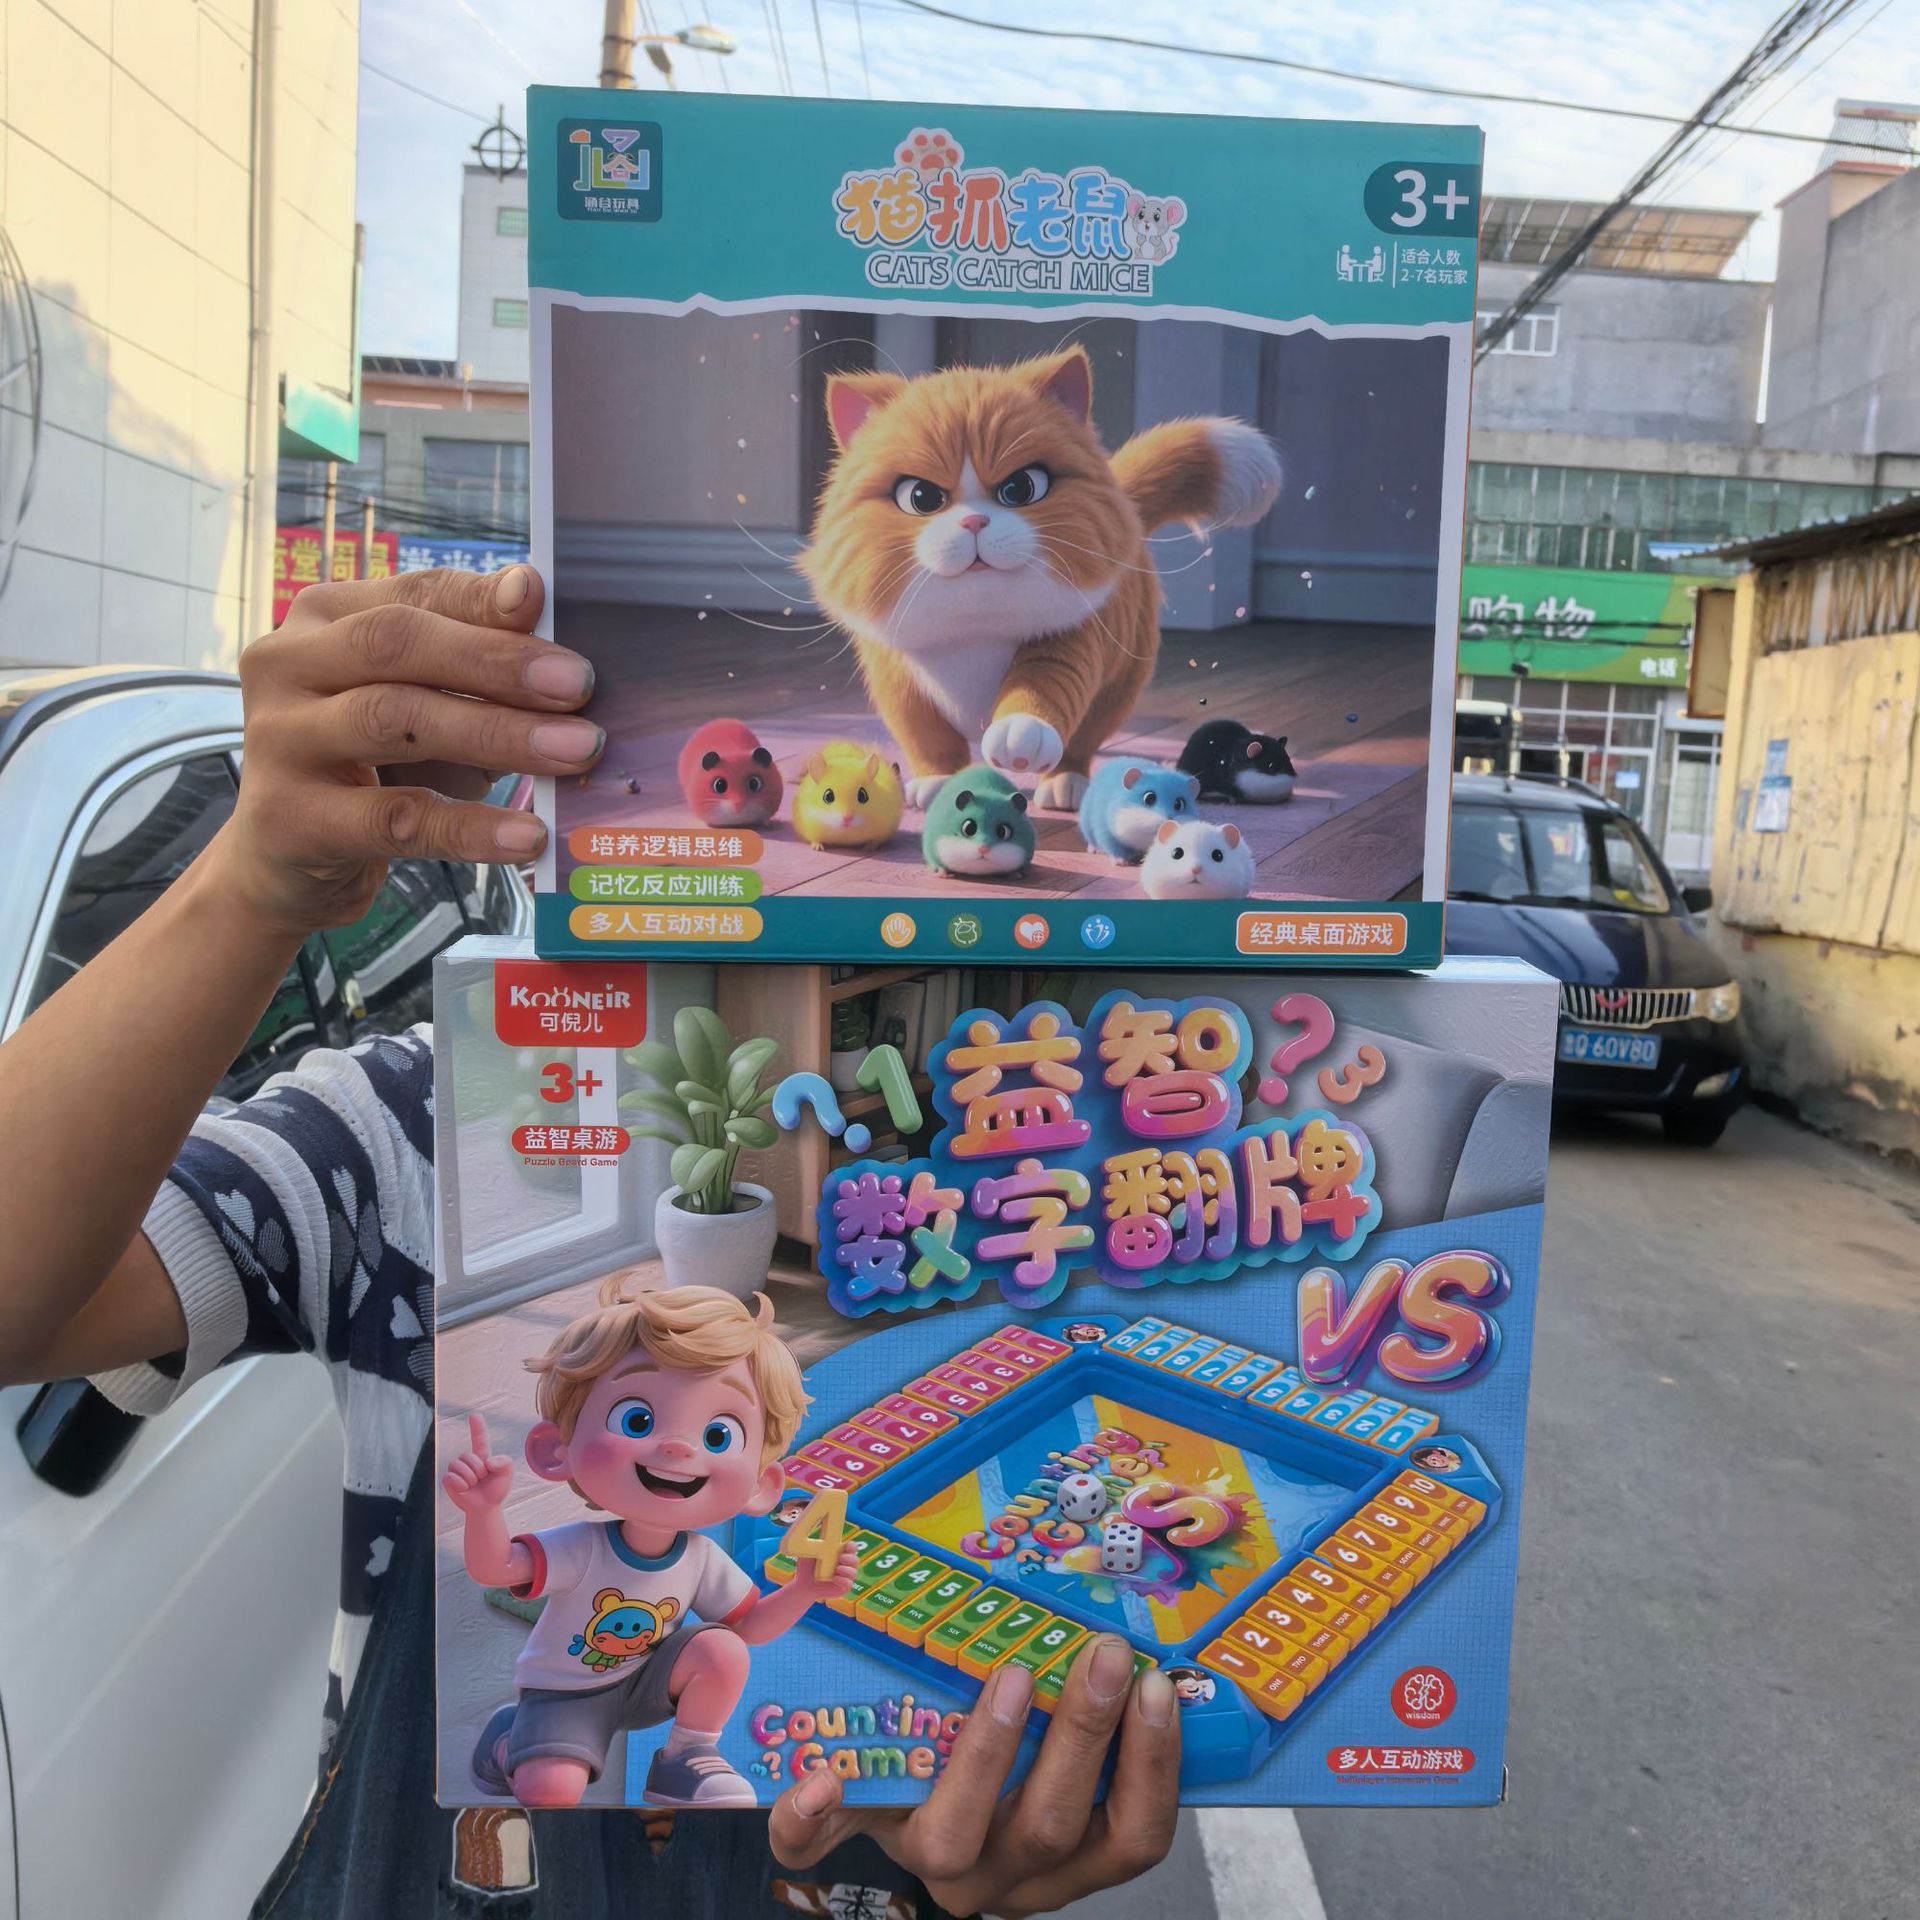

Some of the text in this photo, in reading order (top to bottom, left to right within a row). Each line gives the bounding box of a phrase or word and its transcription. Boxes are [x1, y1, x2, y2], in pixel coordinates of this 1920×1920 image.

[1391, 169, 1469, 228] 3+
[837, 169, 1130, 259] 猫抓老鼠
[1401, 249, 1461, 266] 适合人数
[869, 254, 1151, 293] CATS CATCH MICE
[1401, 268, 1468, 285] 2-7名玩家
[1639, 656, 1678, 679] 电话
[589, 834, 743, 859] 培养逻辑思维
[589, 873, 744, 898] 记忆反应训练
[589, 912, 744, 937] 多人互动对战
[1250, 922, 1393, 946] 经典桌面游戏
[539, 1062, 603, 1104] 3+
[945, 1001, 1239, 1160] 益智
[524, 1127, 618, 1150] 益智桌游
[524, 1157, 618, 1167] Puzzle Board Game
[831, 1119, 1370, 1300] 数字翻牌
[1297, 1249, 1511, 1395] VS
[1037, 1342, 1057, 1351] 1
[1116, 1335, 1136, 1348] 10
[1014, 1353, 1035, 1364] 2
[1143, 1346, 1161, 1356] 9
[1172, 1355, 1192, 1366] 8
[993, 1367, 1014, 1377] 3
[1200, 1367, 1220, 1377] 7
[969, 1380, 989, 1392] 4
[1229, 1375, 1248, 1385] 6
[947, 1394, 969, 1405] 5
[1262, 1388, 1284, 1399] 5
[1292, 1397, 1311, 1408] 4
[919, 1411, 938, 1423] 6
[1324, 1409, 1343, 1420] 3
[900, 1426, 918, 1438] 7
[1354, 1419, 1376, 1432] 2
[1387, 1431, 1402, 1444] 1
[869, 1443, 891, 1454] 8
[845, 1459, 865, 1471] 9
[814, 1474, 843, 1489] 10
[1409, 1478, 1437, 1494] 10
[1393, 1496, 1416, 1510] 9
[1374, 1513, 1398, 1528] 8
[779, 1488, 848, 1581] 4
[1353, 1530, 1376, 1546] 7
[875, 1554, 899, 1569] 3
[1337, 1548, 1359, 1563] 6
[908, 1569, 931, 1584] 4
[1310, 1570, 1333, 1586] 5
[936, 1582, 962, 1598] 5
[1292, 1588, 1315, 1604] 4
[874, 1593, 895, 1605] FOUR
[908, 1608, 924, 1620] FIVE
[976, 1600, 1000, 1614] 6
[1007, 1612, 1034, 1628] 7
[1266, 1609, 1291, 1626] 3
[947, 1627, 961, 1636] SIX
[1042, 1629, 1067, 1646] 8
[1243, 1630, 1270, 1648] 2
[976, 1640, 1000, 1655] SEVEN
[1220, 1653, 1244, 1667] 1
[1291, 1655, 1307, 1669] TWO
[1269, 1678, 1284, 1691] ONE
[1405, 1711, 1440, 1720] wisdom
[790, 1742, 936, 1781] Game
[1338, 1749, 1463, 1770] 多人互动游戏
